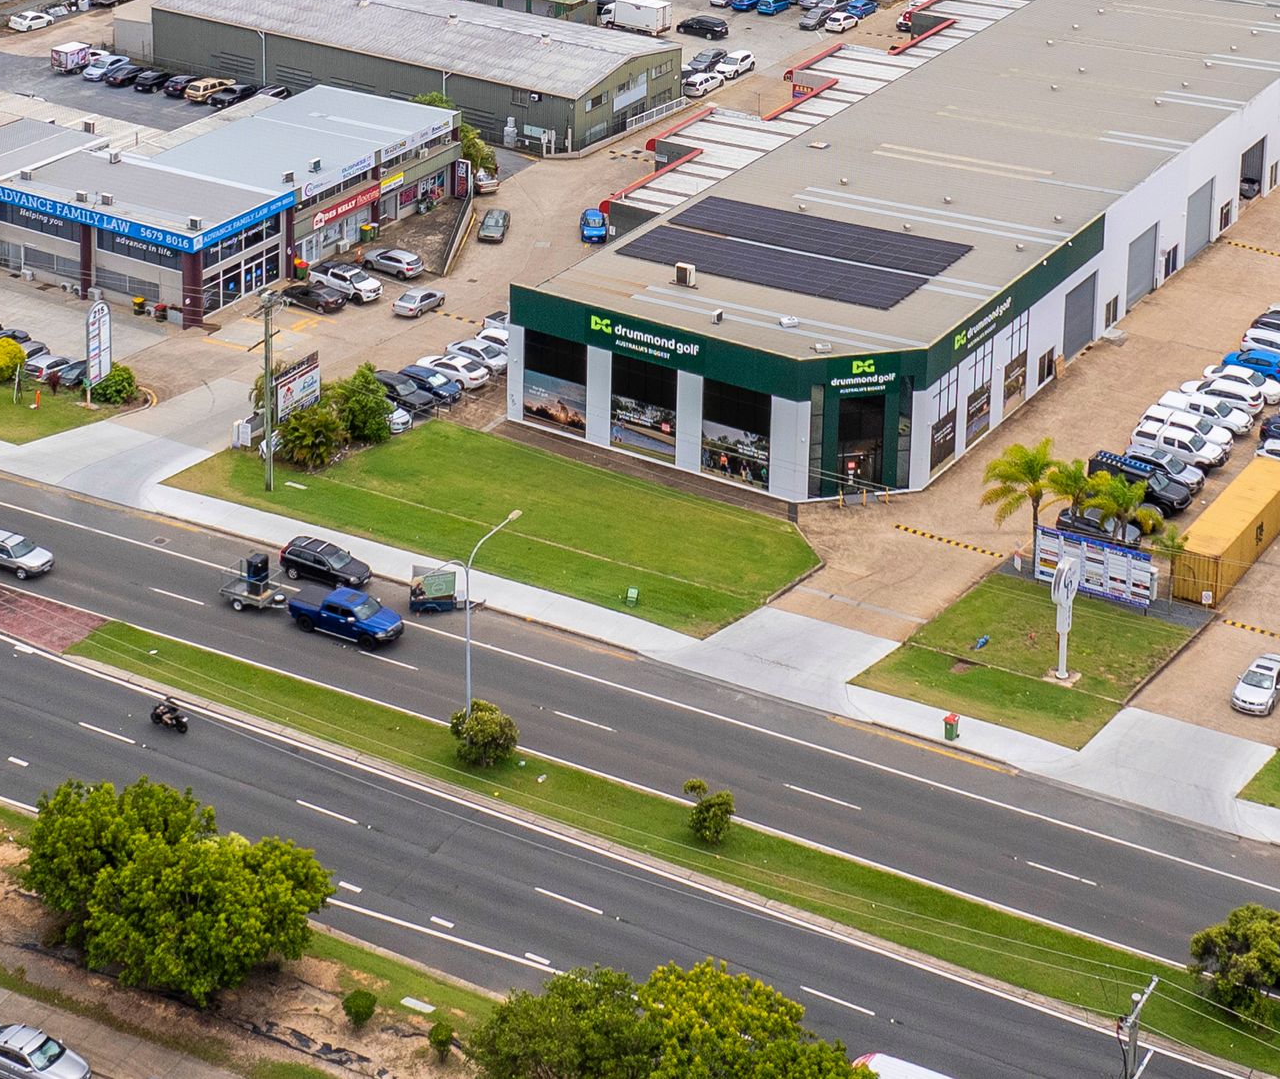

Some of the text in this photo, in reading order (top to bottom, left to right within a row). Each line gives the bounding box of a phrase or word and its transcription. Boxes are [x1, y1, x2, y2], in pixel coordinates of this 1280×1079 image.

[337, 199, 357, 214] KELLY
[19, 208, 64, 227] Helping you
[56, 203, 100, 225] FAMILY
[103, 216, 131, 234] LAW
[140, 227, 163, 241] 5679
[165, 235, 189, 249] 8016
[203, 223, 233, 243] ADVANCE
[232, 213, 255, 229] FAMILY
[255, 206, 269, 219] LAW
[115, 236, 147, 250] advance
[590, 314, 700, 356] DG drummond golf
[852, 359, 875, 374] DG
[830, 372, 896, 386] drummond golf
